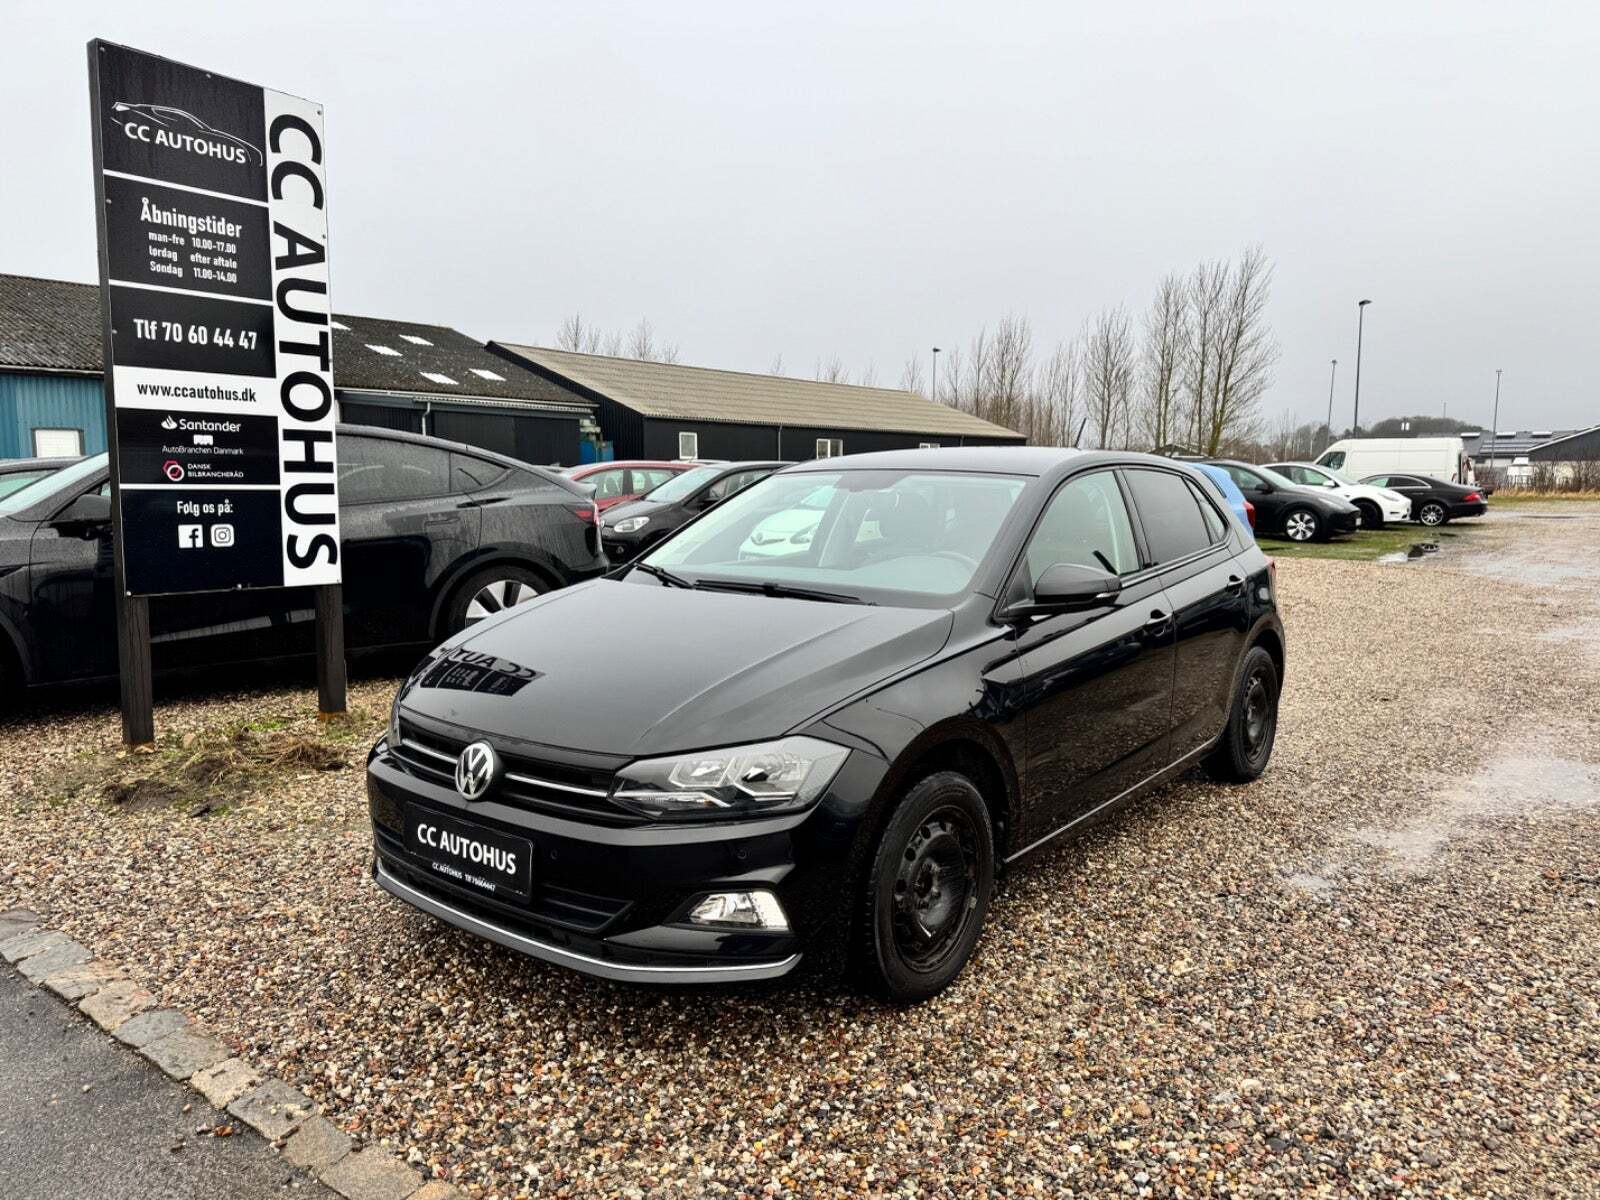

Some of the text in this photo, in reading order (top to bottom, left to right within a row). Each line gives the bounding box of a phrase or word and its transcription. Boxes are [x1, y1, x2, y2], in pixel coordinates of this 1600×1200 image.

[124, 122, 246, 163] CC AUTOHUS
[140, 196, 242, 238] Åbningstider
[148, 231, 237, 254] man-fre 10.00-17.00
[150, 260, 238, 283] Søndag 11.00-14.00
[189, 252, 211, 265] efter
[213, 256, 238, 269] aftale
[133, 318, 257, 350] Tlf 70 60 44 47
[269, 113, 338, 569] CC AUTOHUS
[137, 383, 257, 402] www.ccautohus.dk
[179, 418, 242, 432] Santander
[161, 444, 244, 456] AutoBranchen Danmark
[176, 498, 234, 517] Følg os på:
[417, 823, 517, 875] CC AUTOHUS
